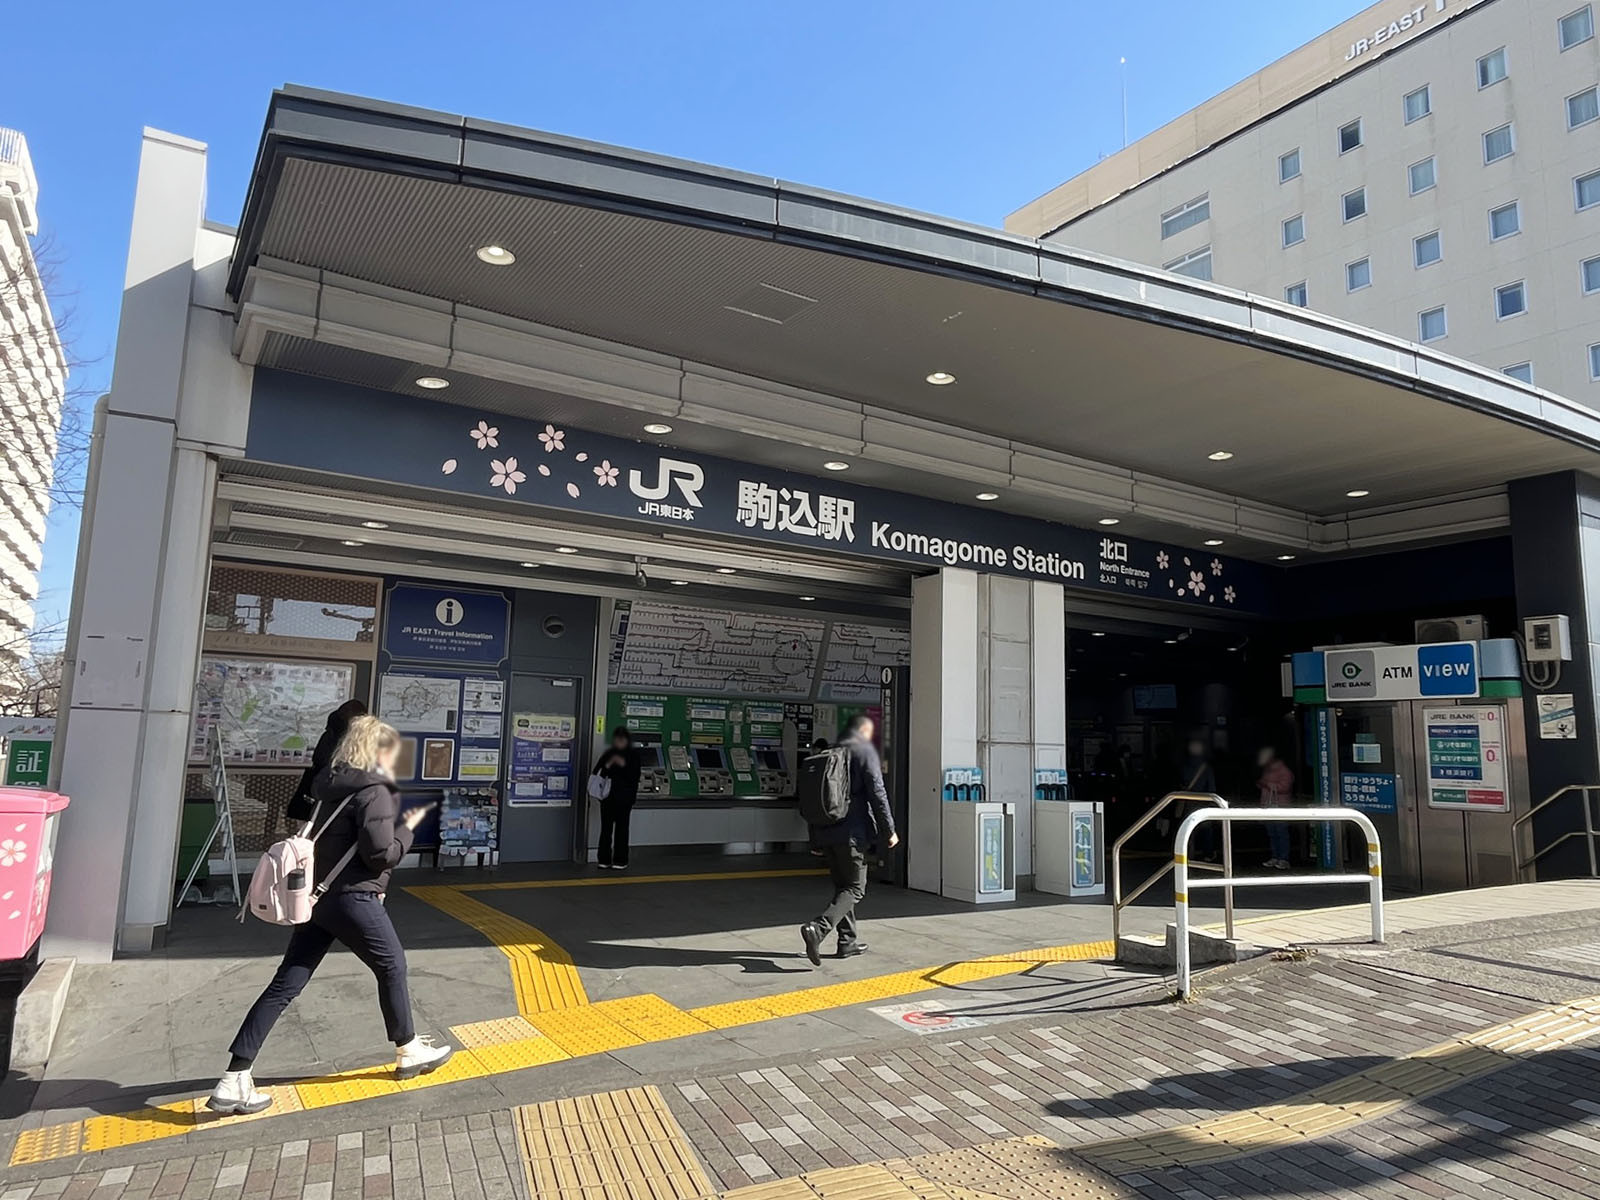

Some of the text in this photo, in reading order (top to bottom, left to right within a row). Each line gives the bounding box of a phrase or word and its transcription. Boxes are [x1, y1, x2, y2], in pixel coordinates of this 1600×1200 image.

[1344, 4, 1427, 61] JR-EAST
[629, 457, 704, 508] JR
[638, 502, 694, 521] JR東日本
[736, 480, 855, 543] 駒込駅
[871, 521, 1085, 580] Komagome Station
[1099, 538, 1128, 562] 北口
[1100, 561, 1150, 578] North Entrance
[413, 627, 432, 635] EAST
[433, 629, 455, 637] Travel
[455, 630, 494, 640] Information
[1382, 666, 1413, 679] ATM
[16, 750, 44, 772] 証
